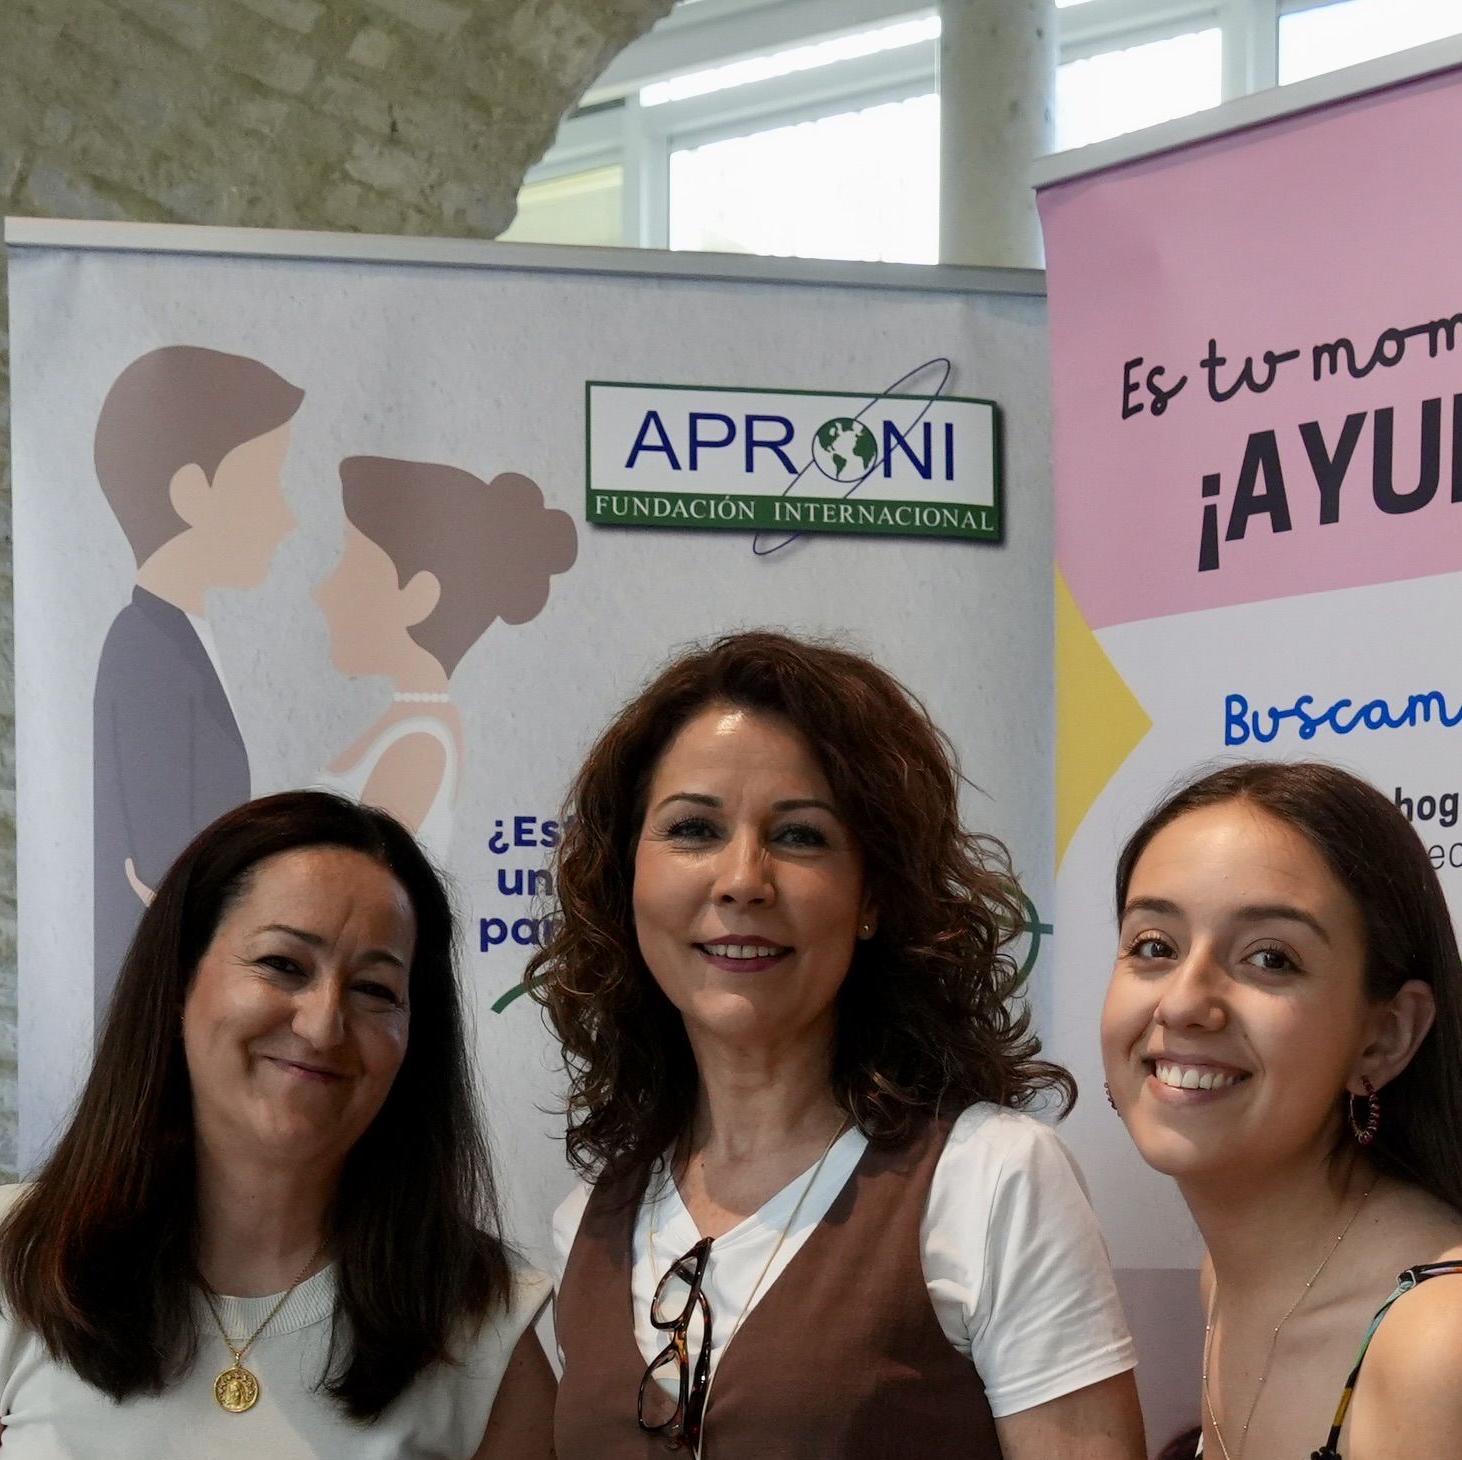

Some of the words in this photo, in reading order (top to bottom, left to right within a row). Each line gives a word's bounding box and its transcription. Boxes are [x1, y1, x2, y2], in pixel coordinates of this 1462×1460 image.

[1122, 360, 1188, 420] Es
[1200, 340, 1300, 403] tu
[625, 409, 957, 483] APRONI
[594, 494, 757, 521] FUNDACIÓN
[772, 501, 996, 533] INTERNACIONAL
